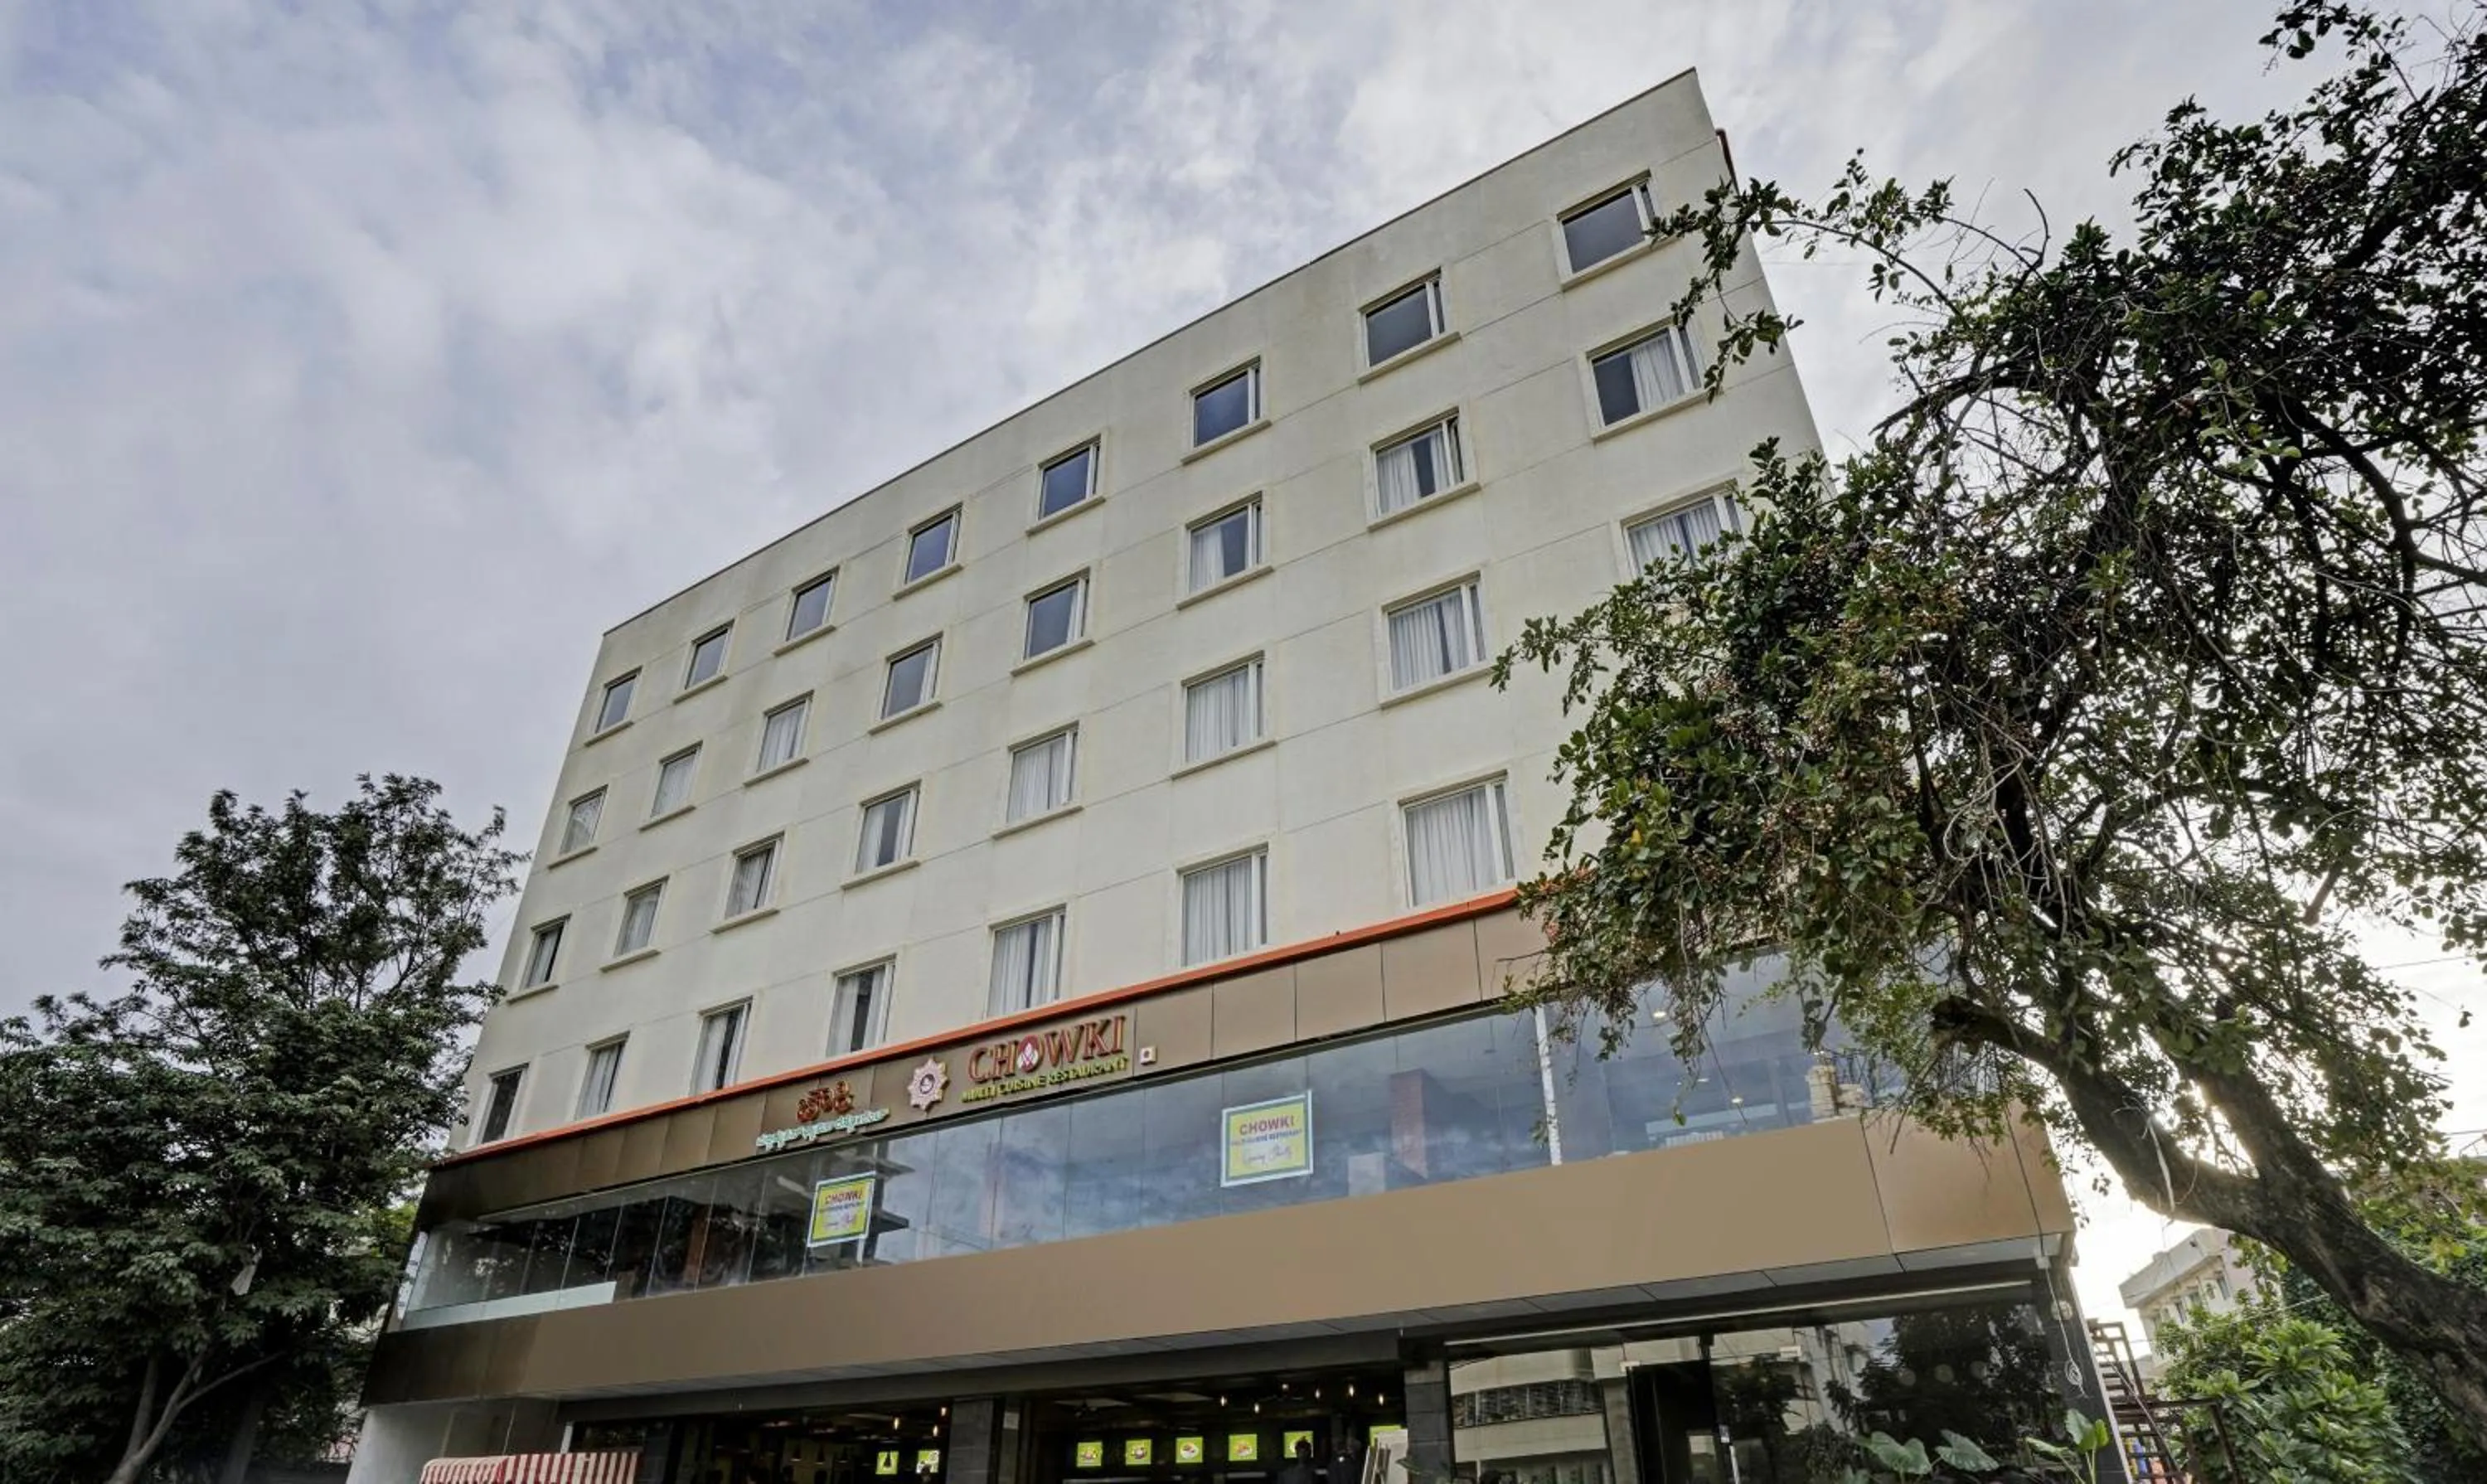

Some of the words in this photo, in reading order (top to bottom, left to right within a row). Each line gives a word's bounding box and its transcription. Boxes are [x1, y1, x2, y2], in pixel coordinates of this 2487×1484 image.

[968, 1016, 1126, 1084] CHOWKI
[999, 1074, 1047, 1095] CUISINE
[1048, 1056, 1129, 1085] RESTAURANT
[1239, 1115, 1295, 1136] CHOWKI
